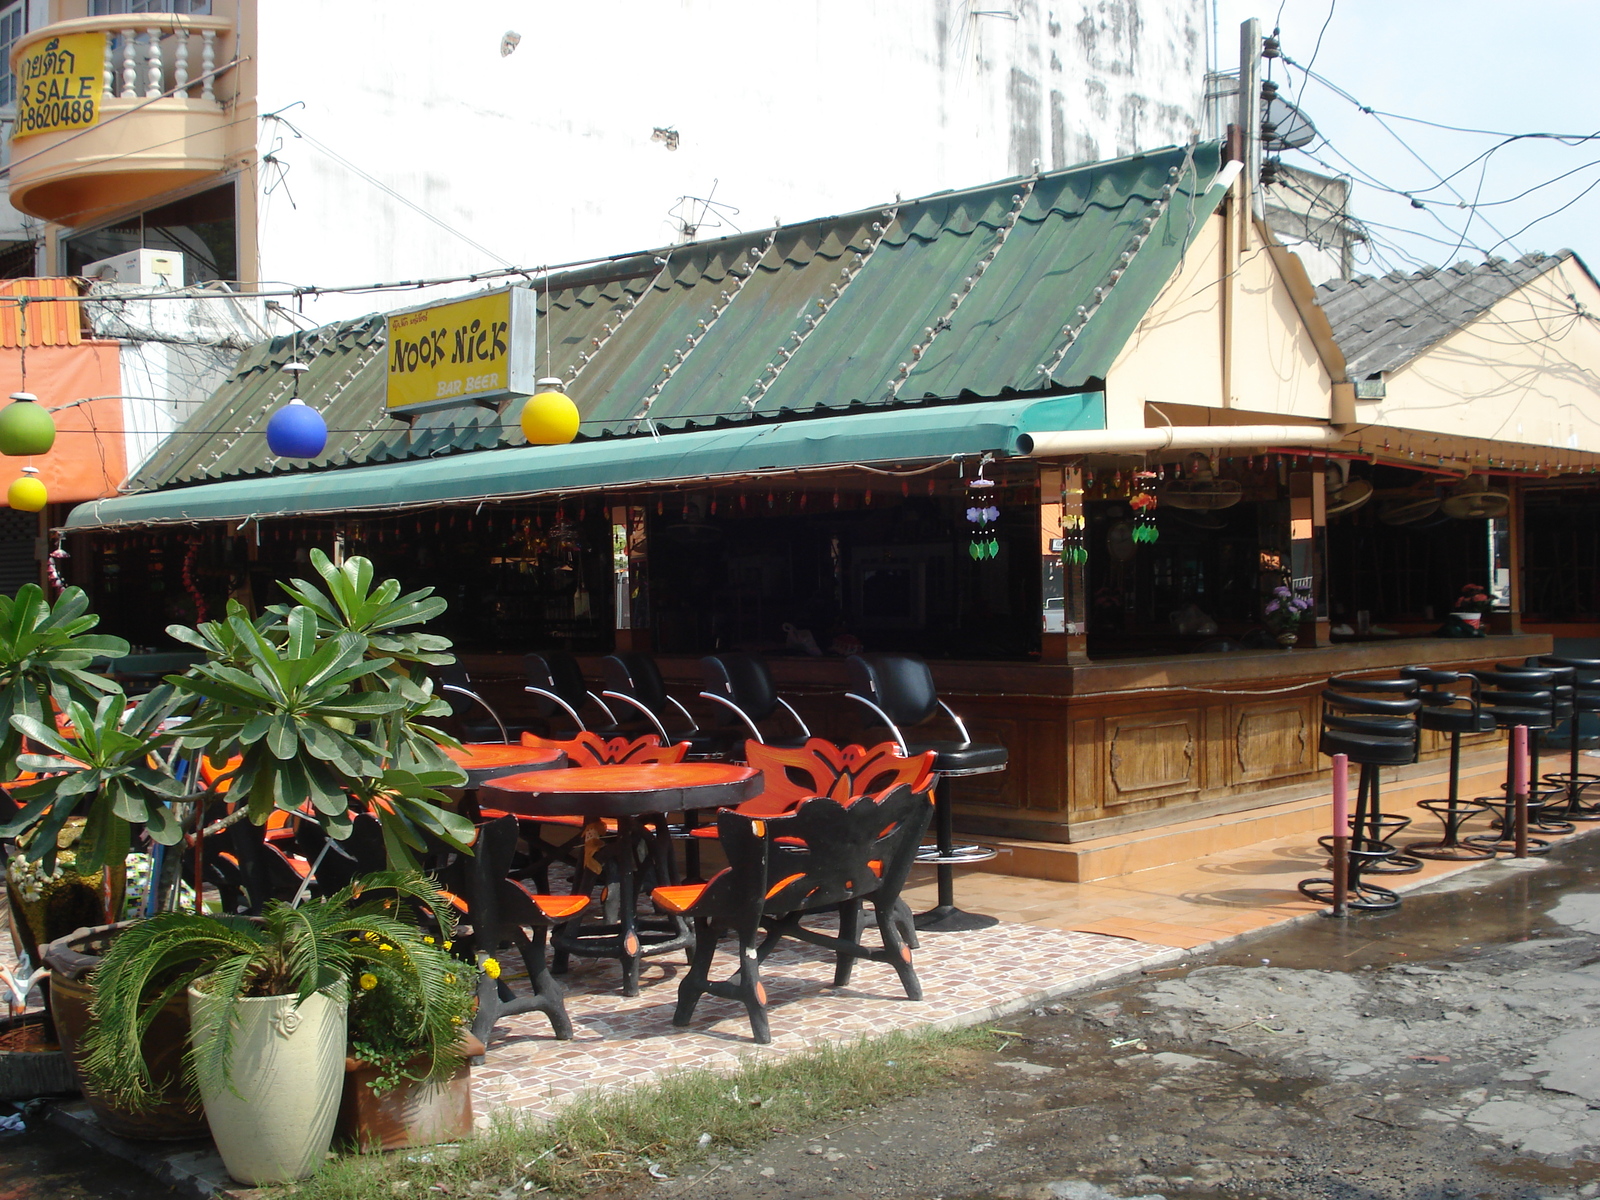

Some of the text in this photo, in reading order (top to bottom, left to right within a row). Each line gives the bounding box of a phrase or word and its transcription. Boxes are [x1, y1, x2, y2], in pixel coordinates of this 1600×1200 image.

[22, 38, 75, 80] ายตึก
[36, 76, 95, 104] SALE
[391, 328, 447, 373] NOOK
[436, 373, 499, 397] BAR BEER
